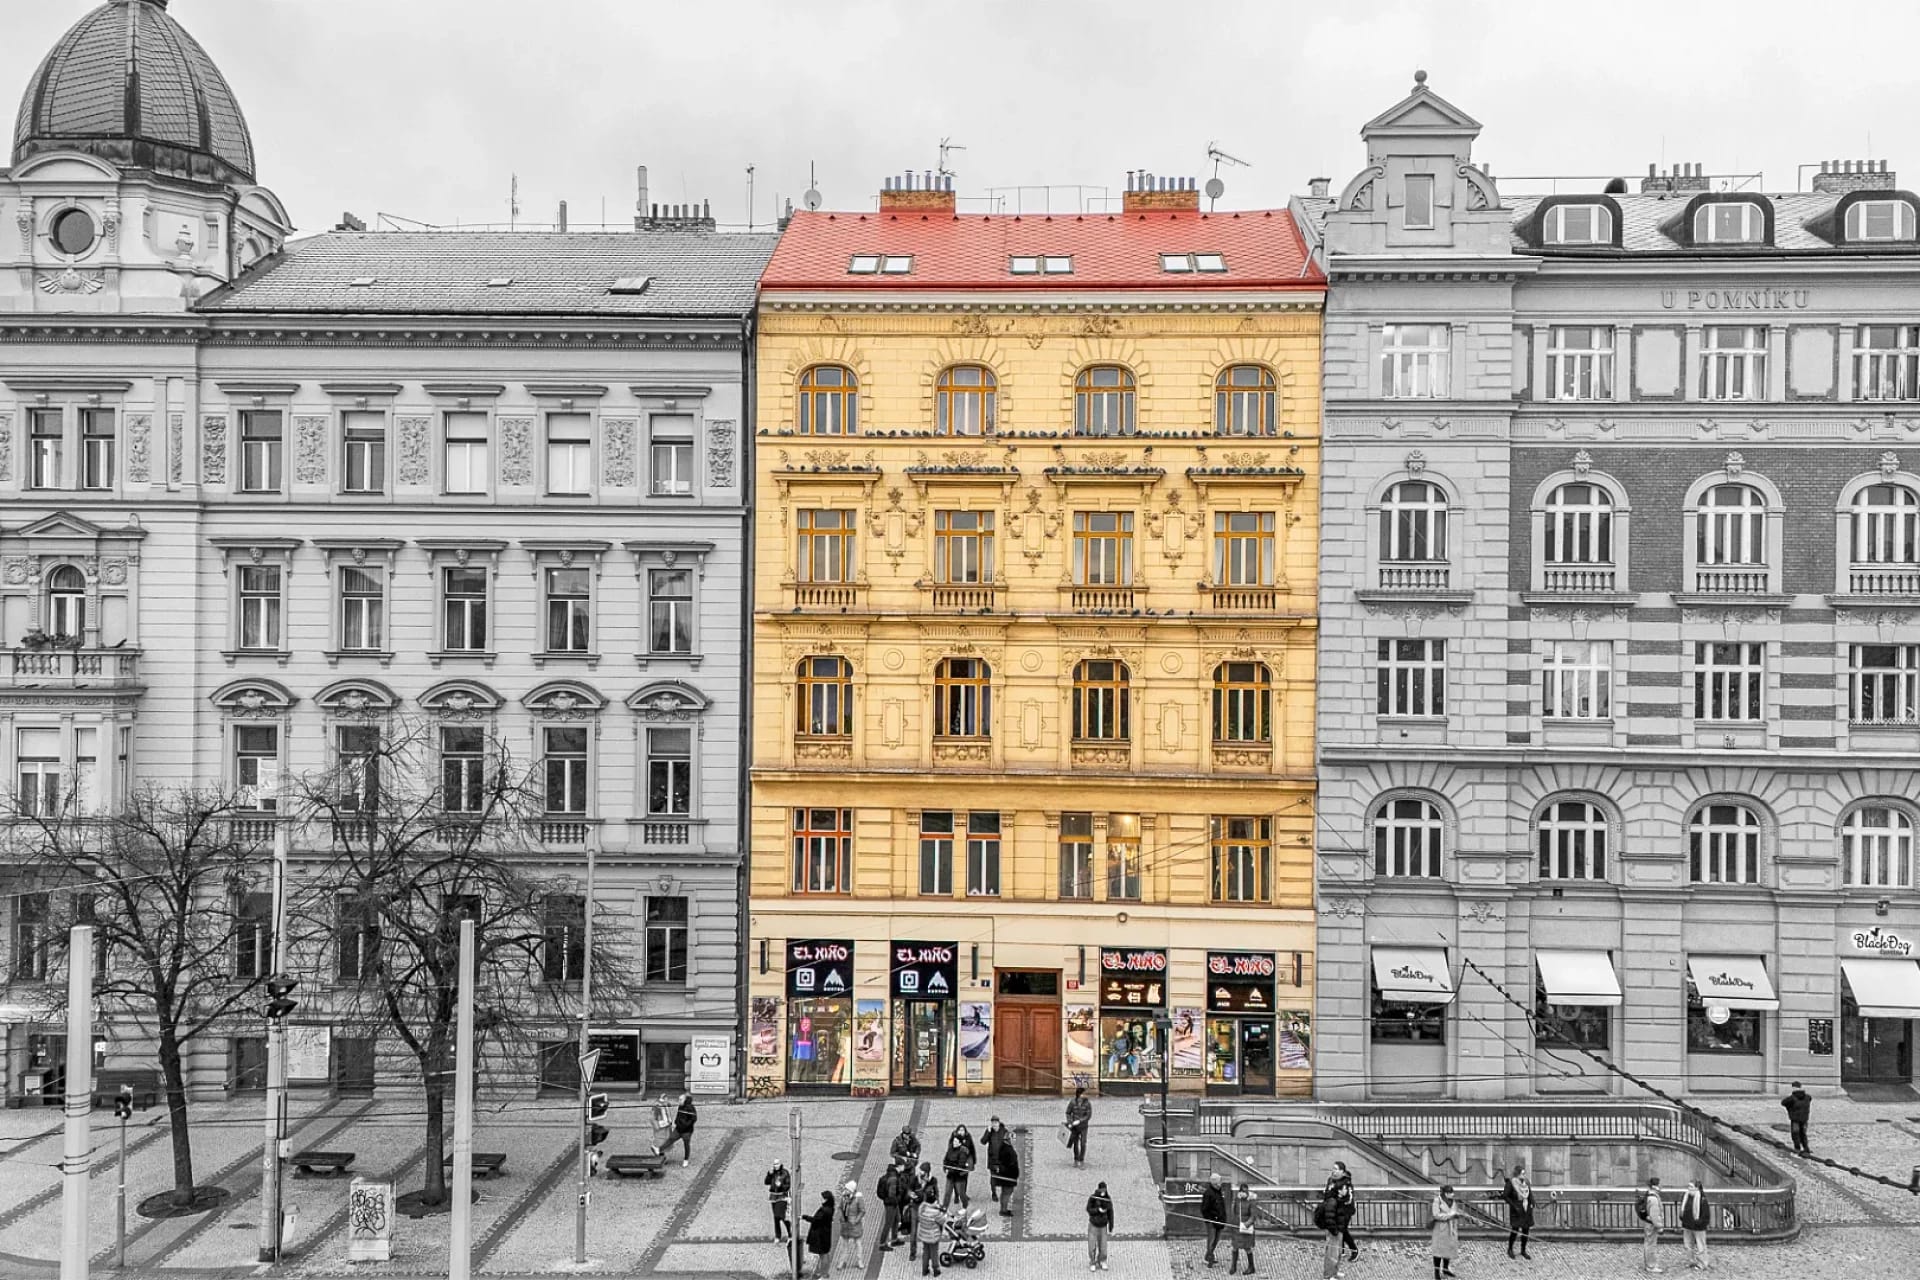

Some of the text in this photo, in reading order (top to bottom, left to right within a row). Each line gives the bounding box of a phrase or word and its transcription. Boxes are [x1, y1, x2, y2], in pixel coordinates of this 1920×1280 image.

[1661, 288, 1809, 309] U POMNÍKU
[793, 944, 848, 961] EL NIÑO
[896, 946, 952, 963] EL NIÑO
[1102, 952, 1126, 970] EL
[1209, 956, 1234, 974] EL
